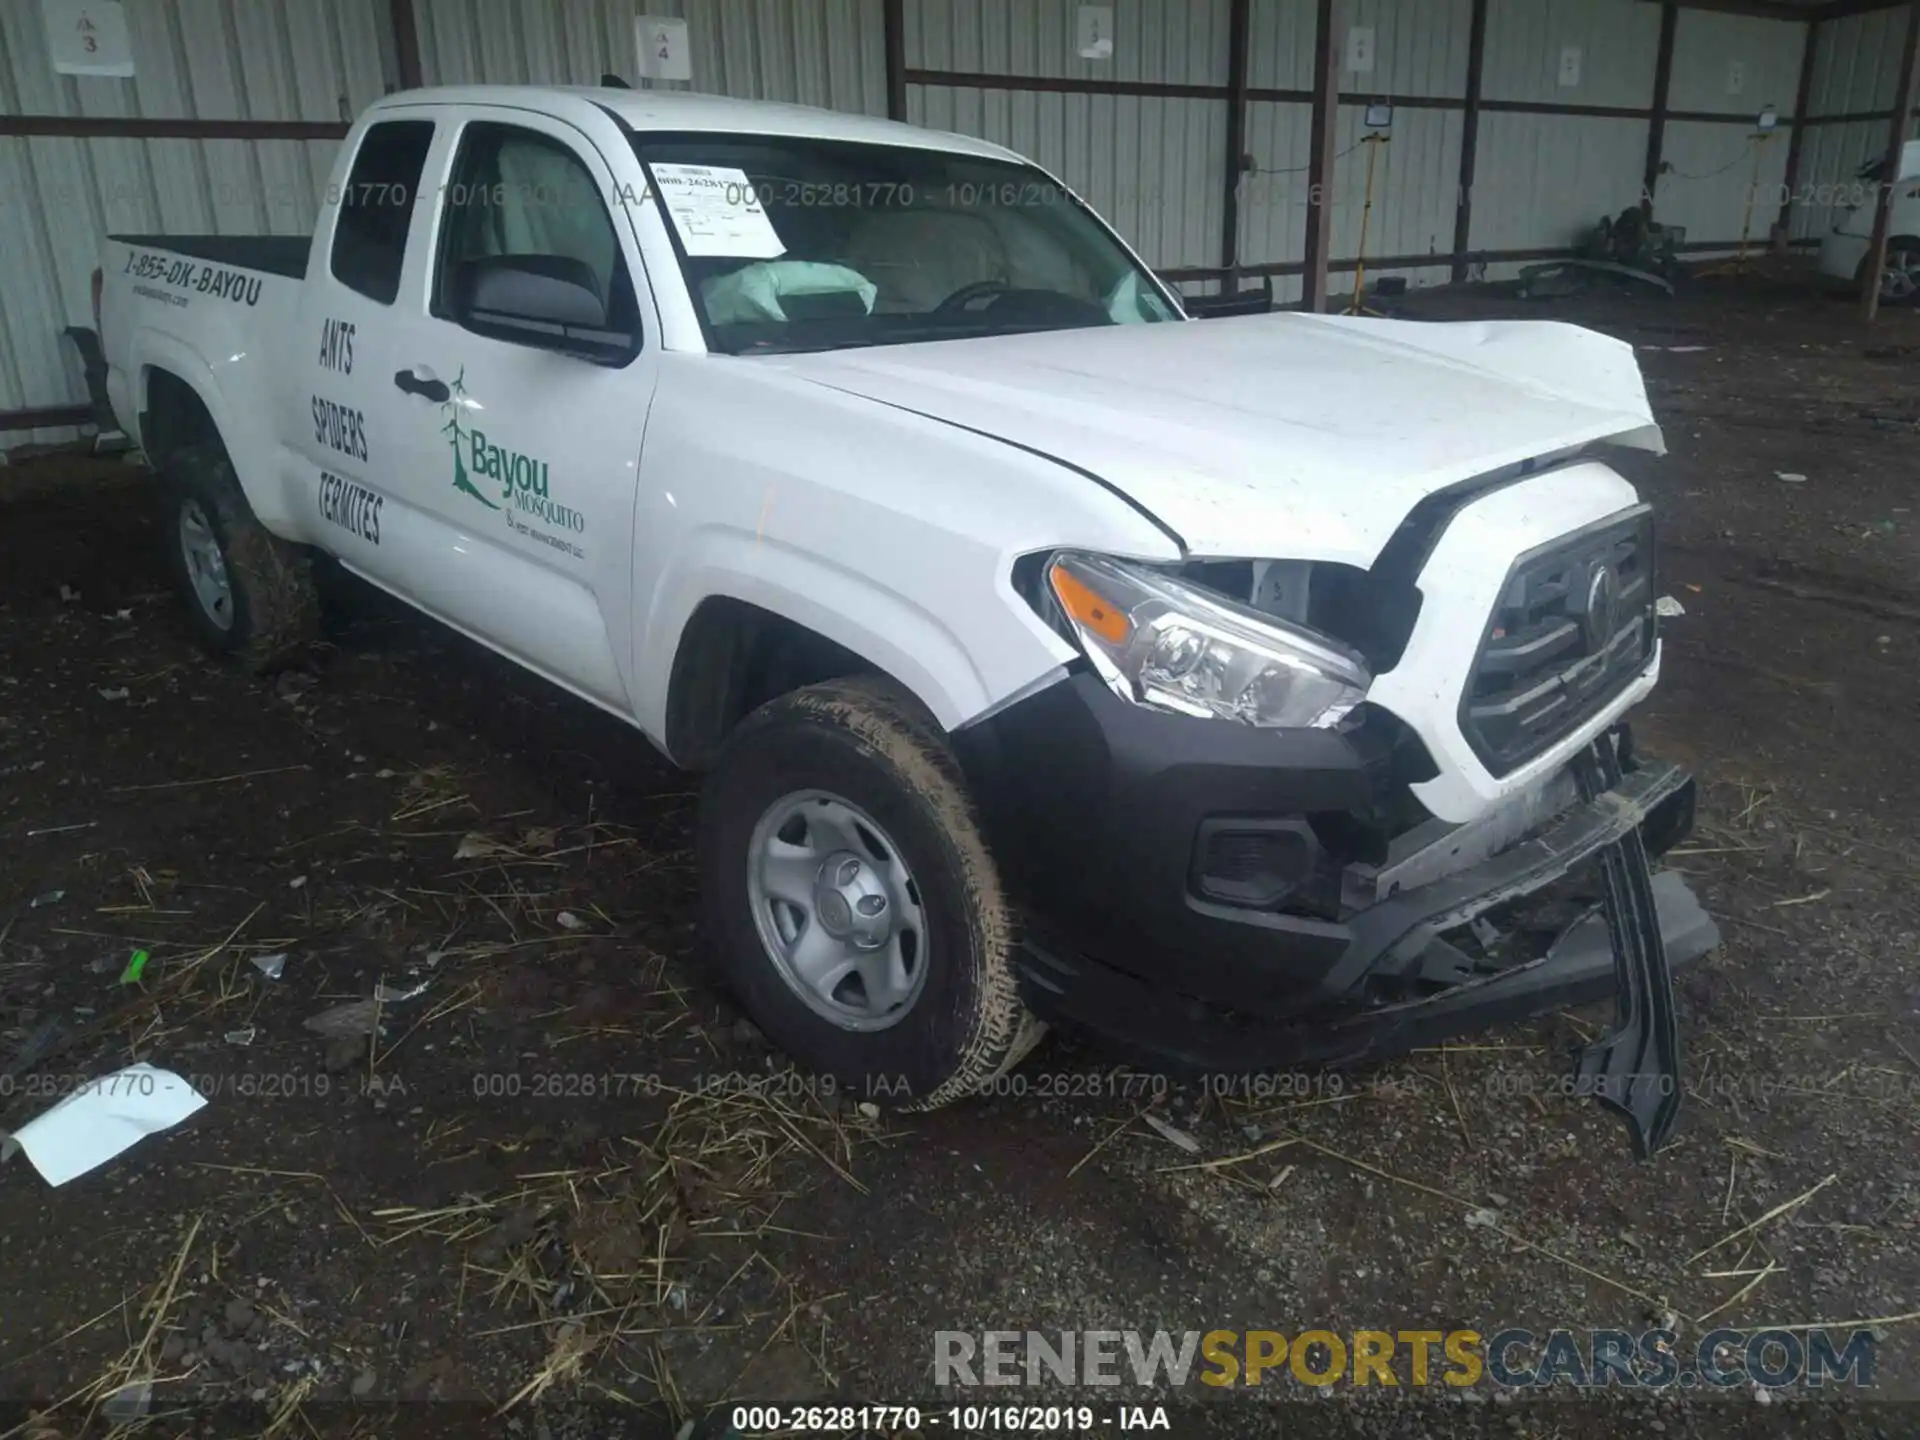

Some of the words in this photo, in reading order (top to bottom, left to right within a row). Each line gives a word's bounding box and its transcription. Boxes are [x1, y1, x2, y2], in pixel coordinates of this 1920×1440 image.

[83, 35, 97, 53] 3
[659, 46, 669, 60] 4
[124, 252, 262, 306] 1-855-OK-BAYOU
[319, 317, 355, 376] ANTS
[312, 394, 368, 463] SPIDERS
[471, 429, 549, 499] Bayou
[319, 472, 384, 545] TERMITES
[514, 489, 584, 533] MOSQUITO
